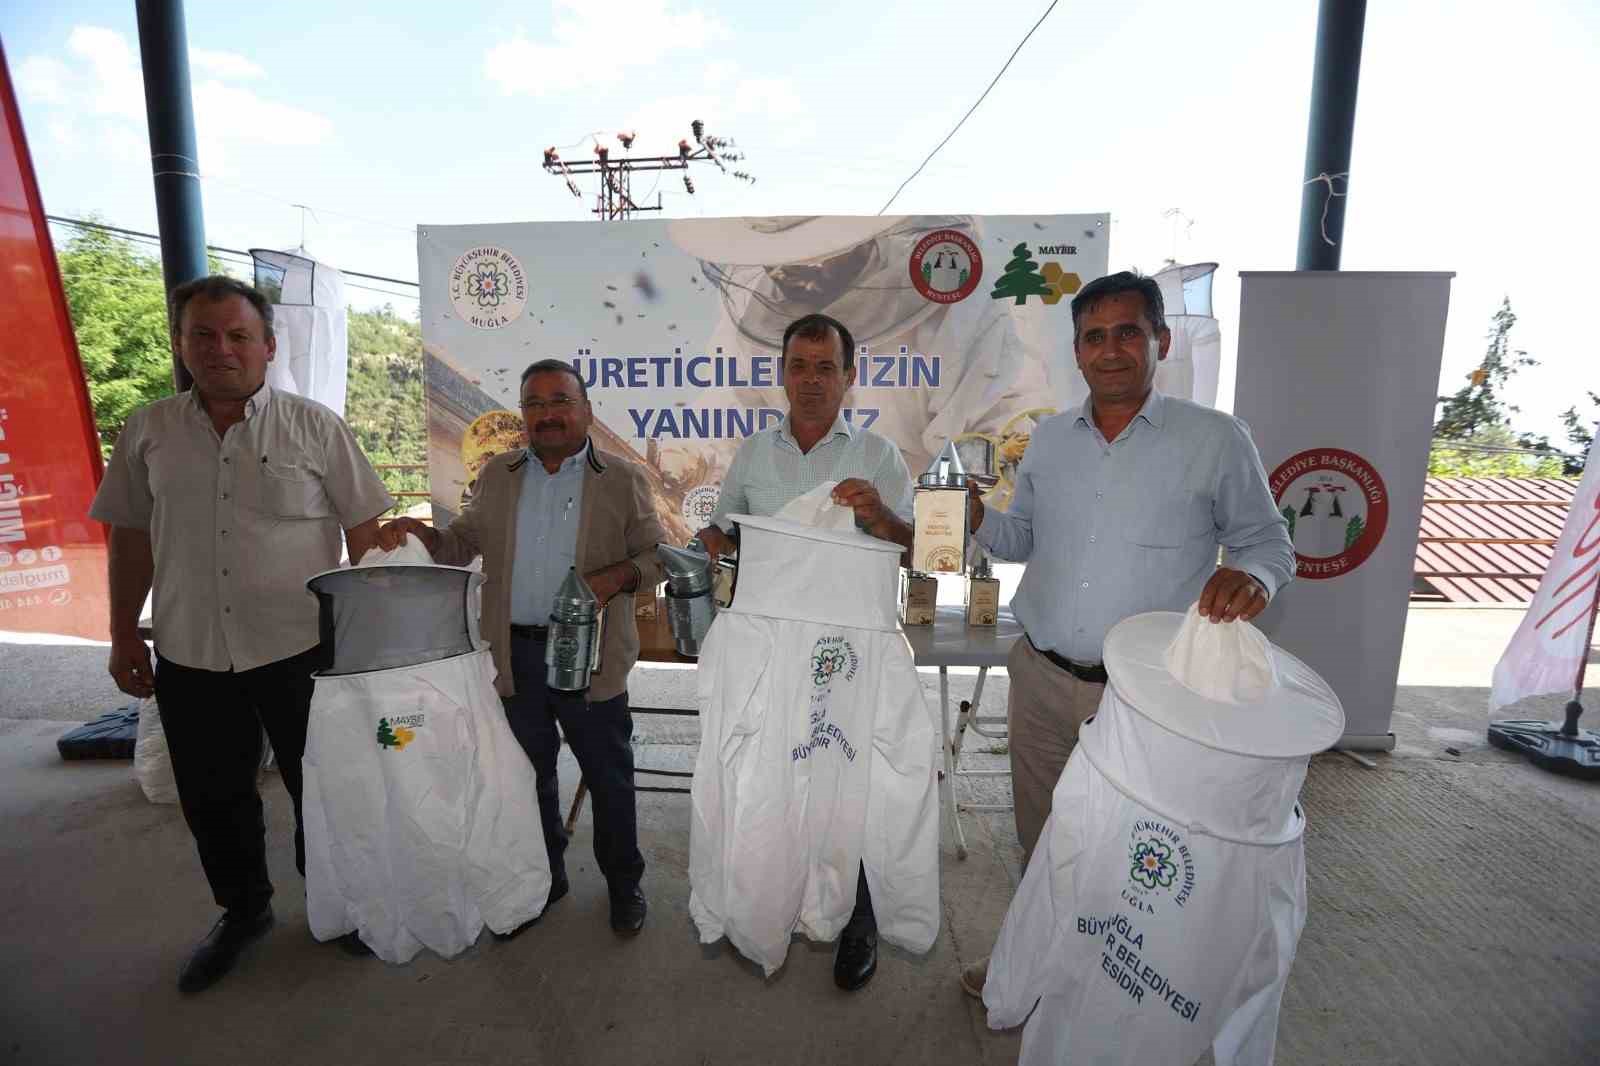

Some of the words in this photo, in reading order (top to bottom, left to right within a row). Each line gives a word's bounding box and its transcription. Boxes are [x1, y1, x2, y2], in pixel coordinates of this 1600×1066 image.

[1269, 455, 1318, 500] ELEDİYE
[1295, 557, 1349, 574] ENTEŞE
[1101, 952, 1145, 1006] ESİDİR
[1115, 943, 1201, 1023] BELEDİYESİ
